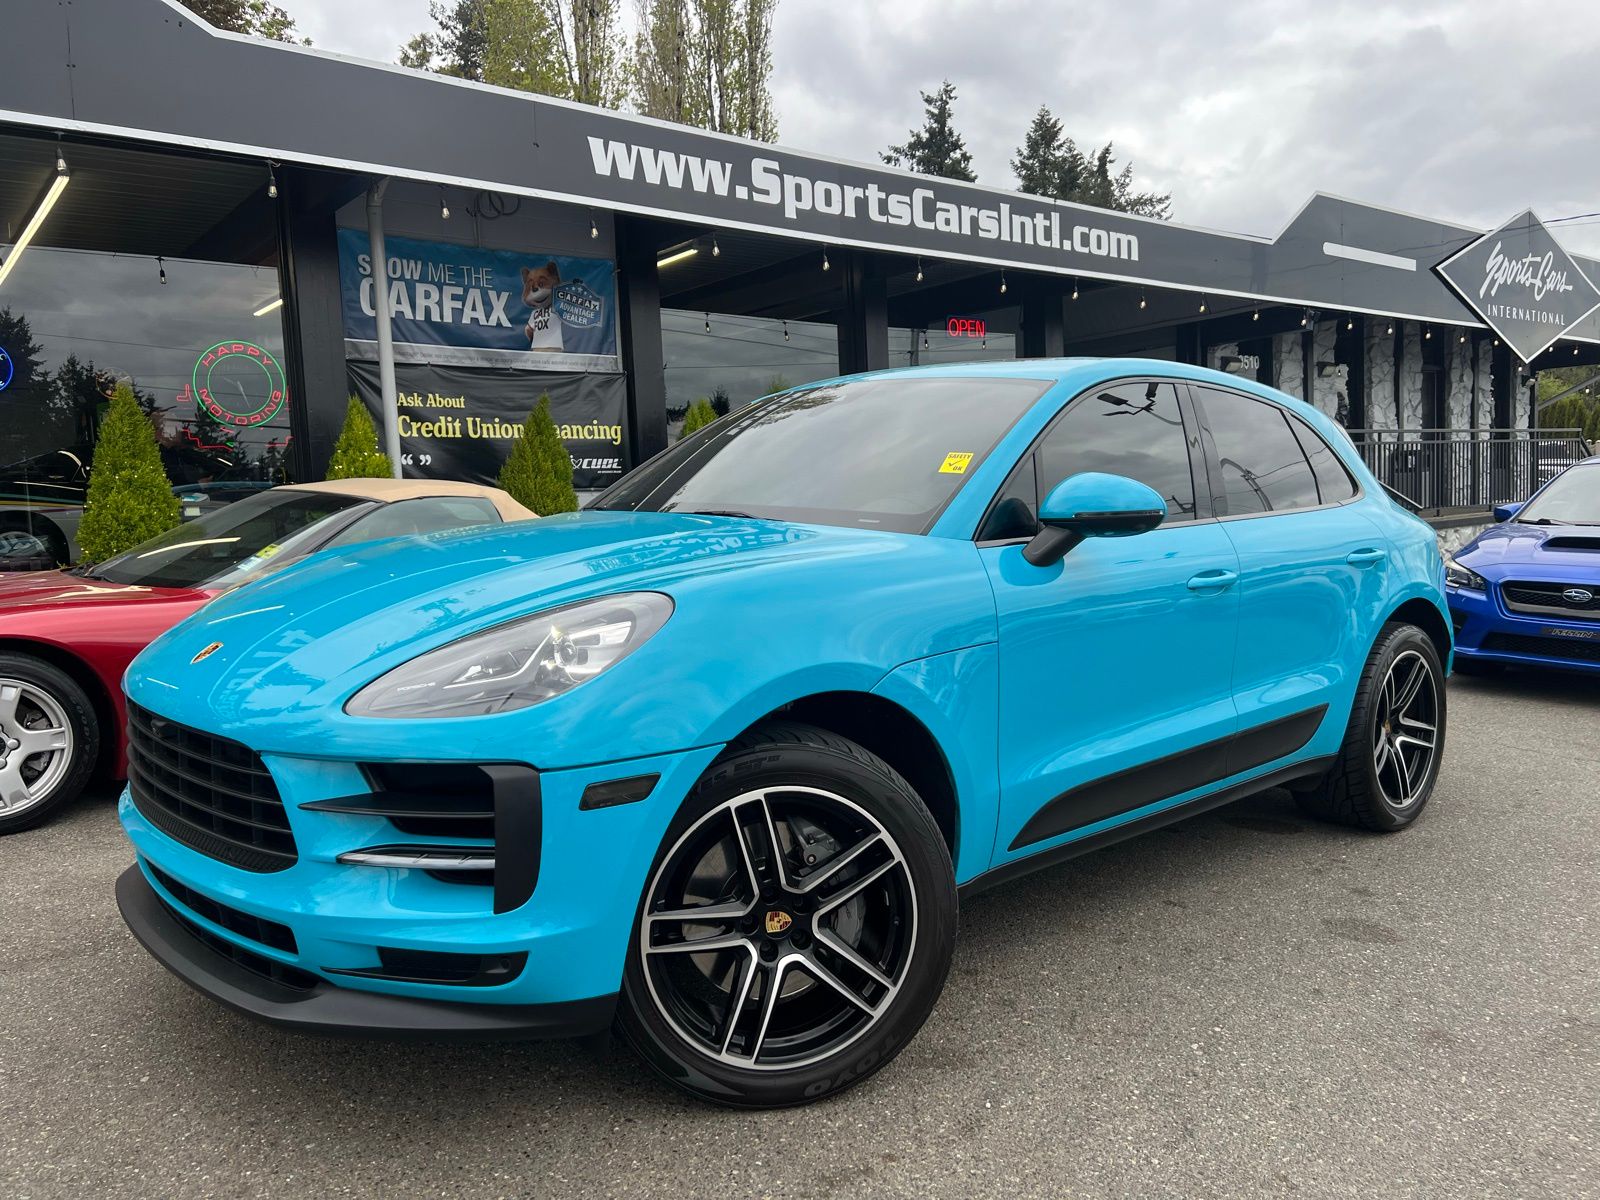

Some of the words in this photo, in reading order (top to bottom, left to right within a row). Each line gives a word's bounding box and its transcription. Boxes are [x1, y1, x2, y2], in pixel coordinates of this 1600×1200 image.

[587, 136, 1139, 261] www.SportsCarsIntl.com
[358, 254, 422, 281] SOW
[428, 261, 455, 283] ME
[460, 266, 493, 288] THE
[1480, 241, 1541, 299] Sports
[1534, 251, 1573, 301] Cars
[359, 277, 513, 328] CARFAX
[558, 291, 600, 311] CARFAX
[560, 302, 595, 319] ADVANTAGE
[562, 312, 588, 325] DEALER
[1488, 304, 1565, 326] INTERNATIONAL
[948, 318, 985, 337] OPEN
[202, 344, 272, 367] HAPPY
[200, 388, 281, 425] MOTORING
[397, 392, 423, 408] Ask
[426, 393, 465, 409] About
[397, 415, 462, 439] Credit
[467, 417, 525, 439] Union
